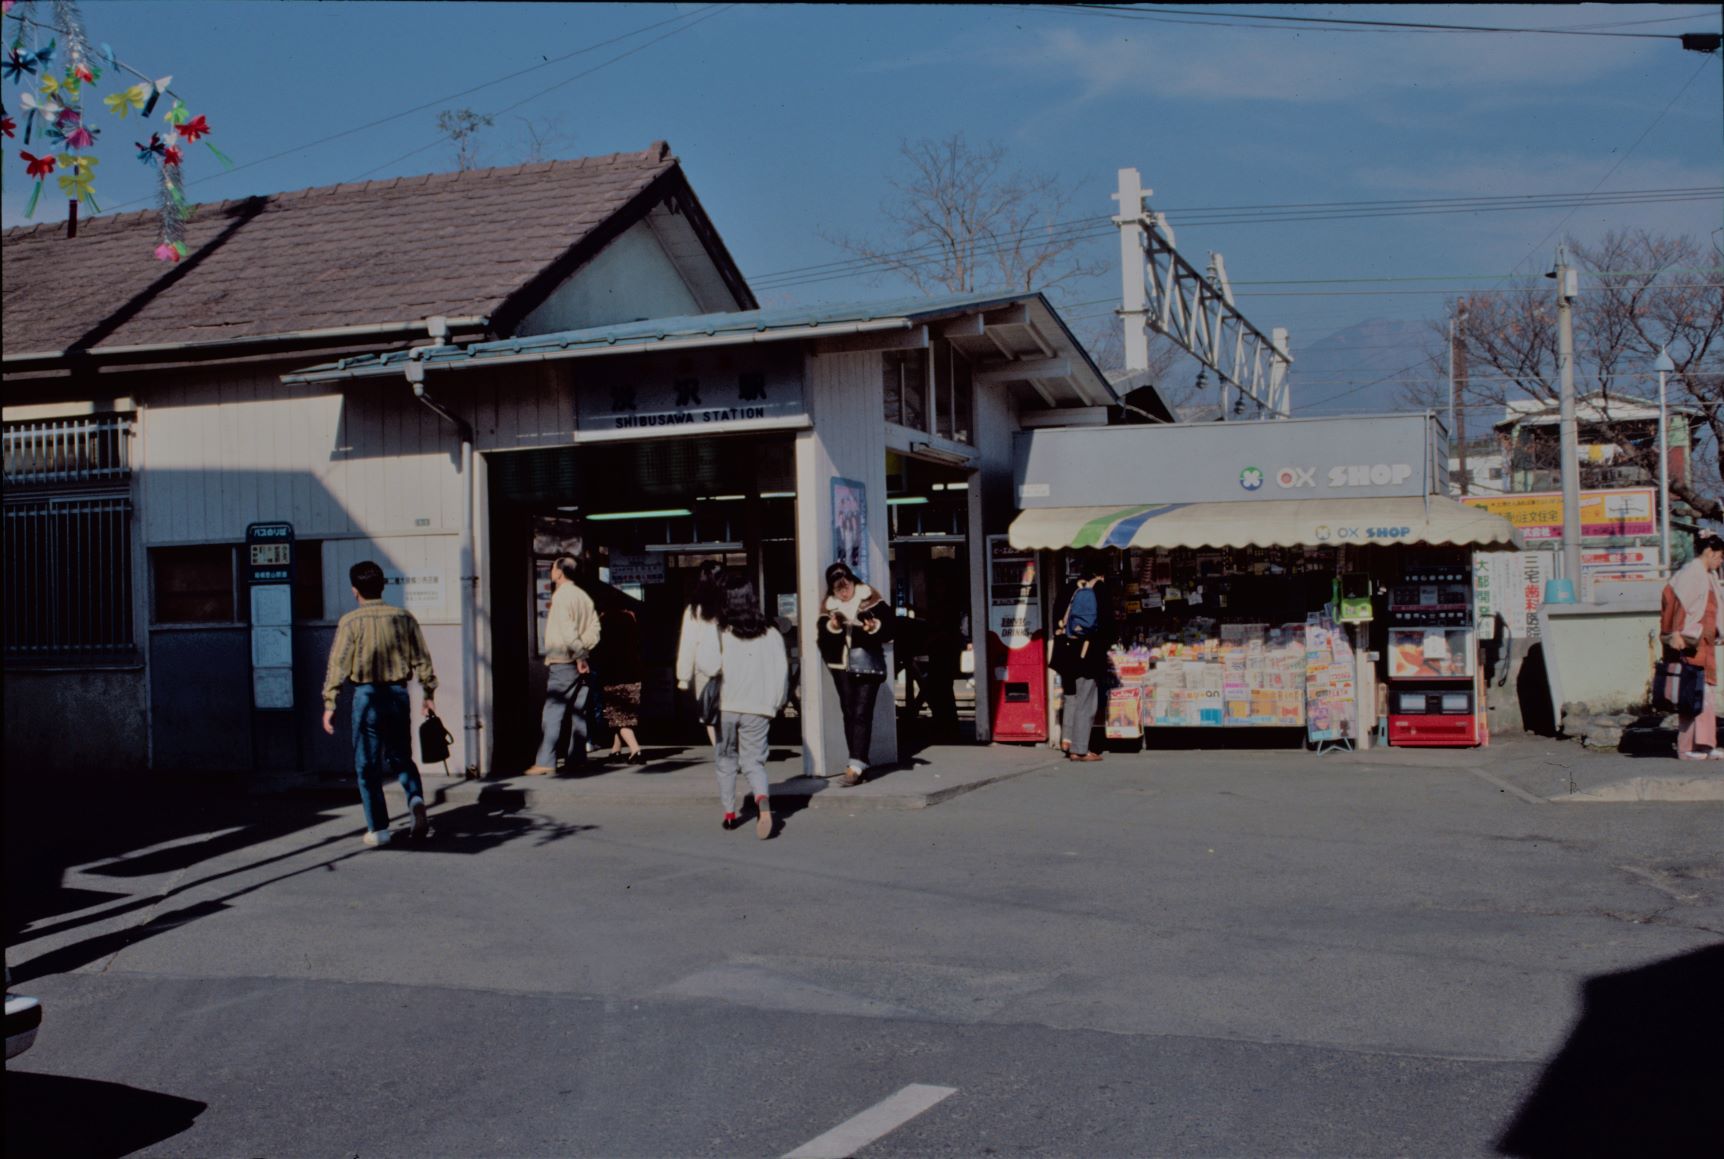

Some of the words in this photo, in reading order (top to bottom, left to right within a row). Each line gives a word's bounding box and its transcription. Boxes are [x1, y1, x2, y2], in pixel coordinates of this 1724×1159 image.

[616, 413, 694, 428] SHIBUSAWA
[704, 407, 765, 422] STATION
[1276, 466, 1316, 489] OX
[1328, 463, 1412, 487] SHOP
[1337, 526, 1359, 538] OX
[1367, 526, 1410, 538] SHOP
